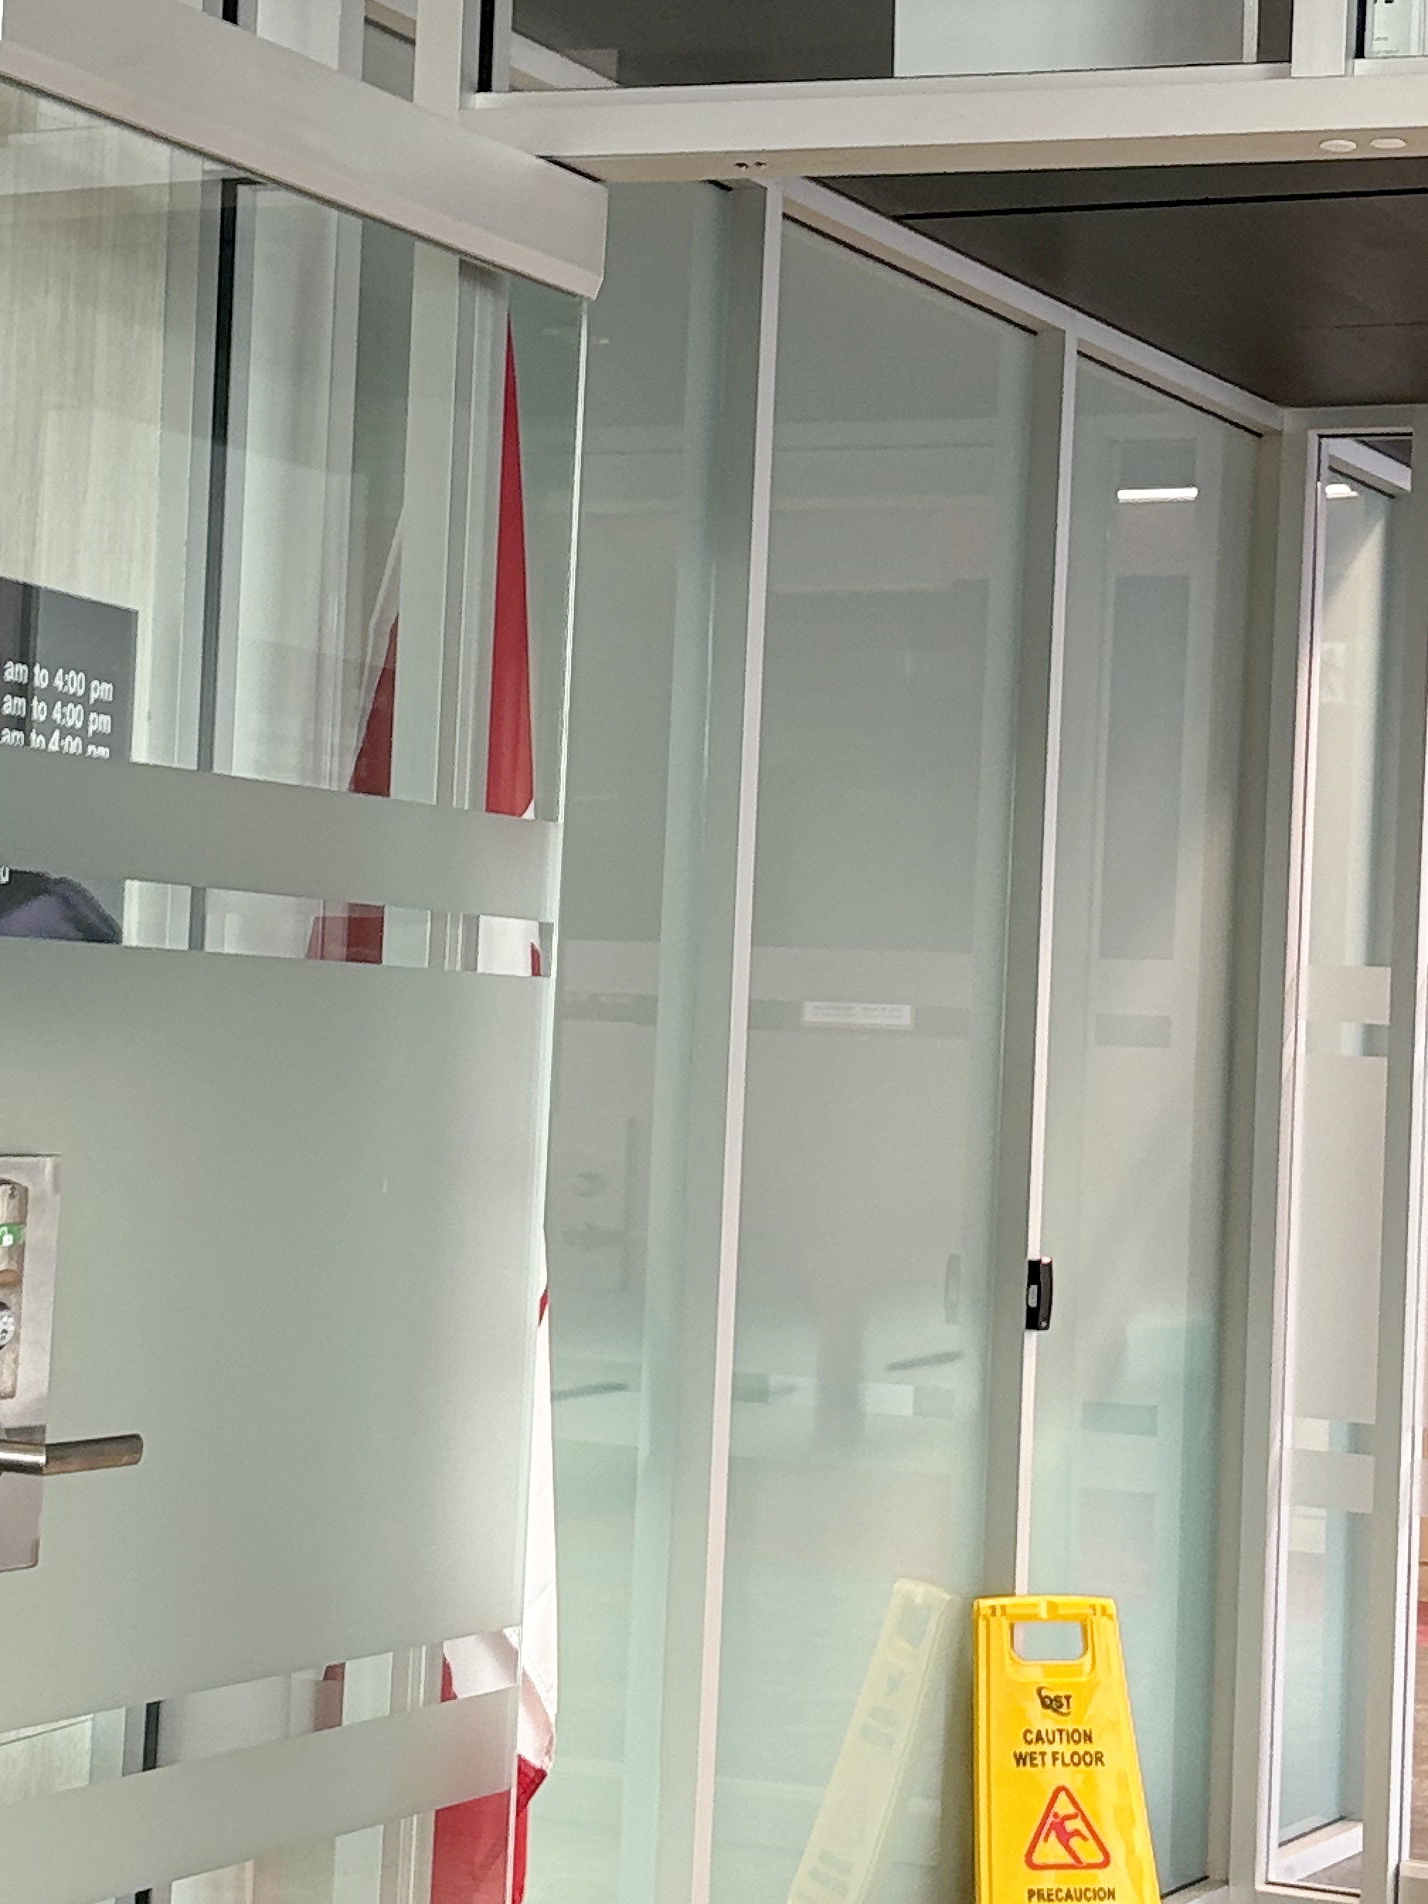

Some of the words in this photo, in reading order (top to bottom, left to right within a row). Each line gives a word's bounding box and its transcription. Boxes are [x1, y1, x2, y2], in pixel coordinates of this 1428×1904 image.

[3, 660, 29, 685] am
[33, 662, 49, 689] to
[52, 668, 86, 697] 4:00
[88, 679, 113, 705] pm
[0, 693, 27, 718] am
[31, 696, 48, 722] to
[51, 700, 84, 730] 4:00
[88, 711, 112, 738] pm
[0, 727, 25, 747] am
[1022, 1727, 1093, 1745] CAUTION
[1013, 1750, 1047, 1768] WET
[1051, 1750, 1105, 1768] FLOOR
